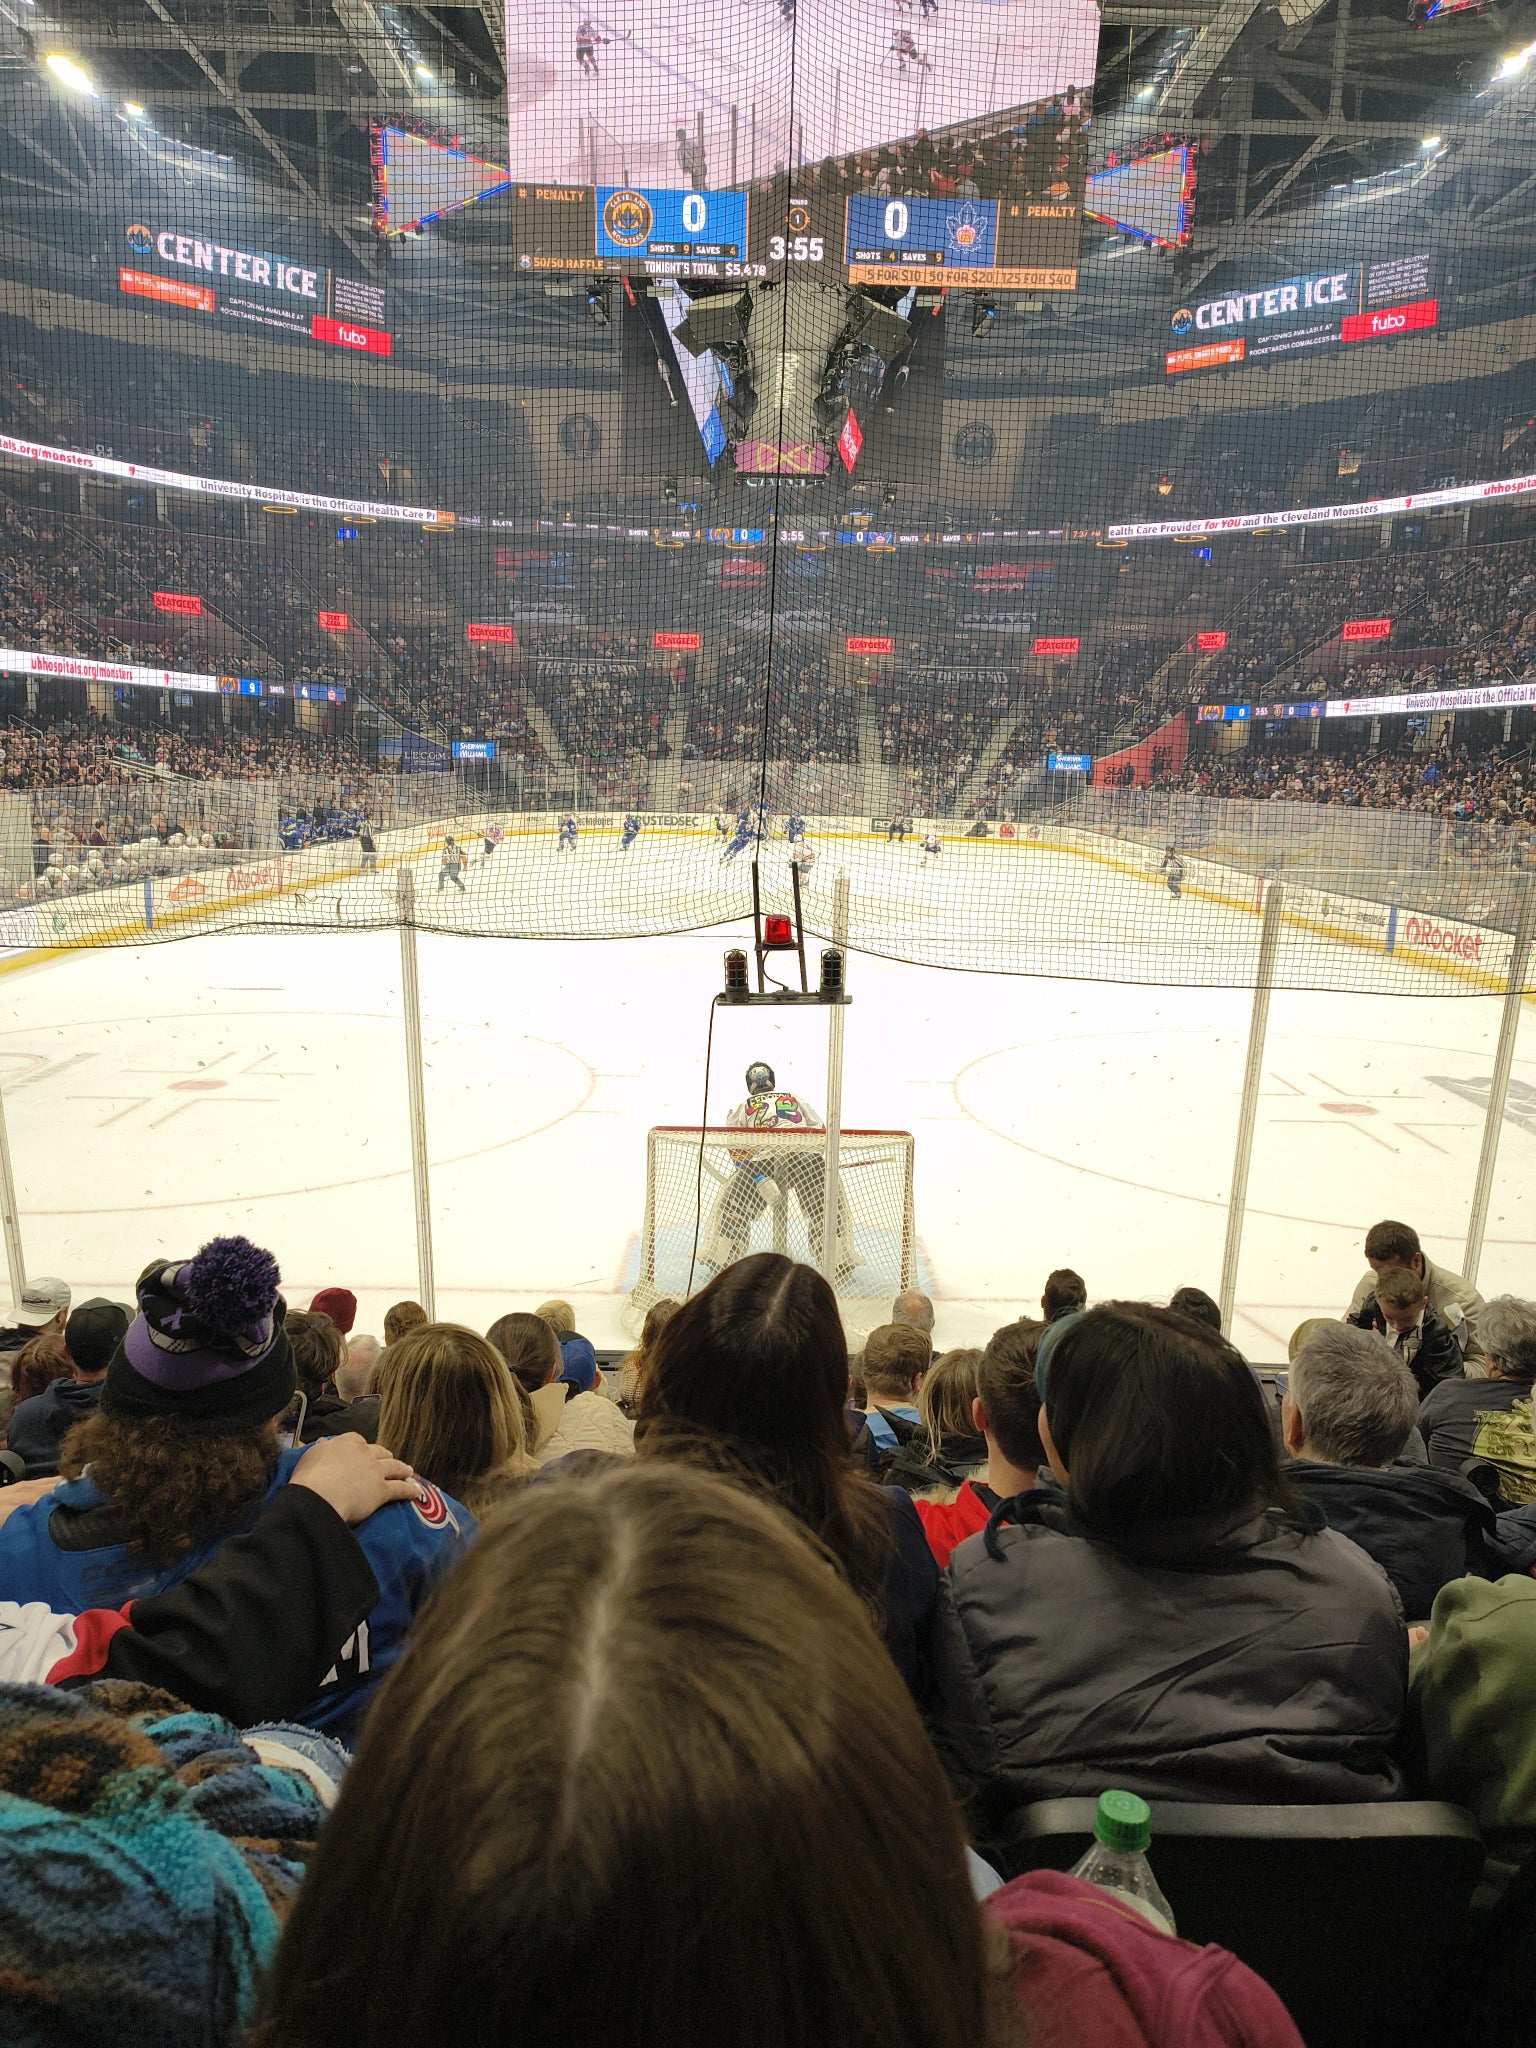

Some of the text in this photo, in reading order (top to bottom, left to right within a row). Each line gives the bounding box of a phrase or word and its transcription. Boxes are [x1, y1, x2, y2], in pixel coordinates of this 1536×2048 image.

[536, 188, 584, 202] PENALTY
[610, 193, 646, 209] CLEVELAND
[683, 194, 706, 232] 0
[794, 214, 800, 224] 1
[884, 201, 908, 239] 0
[1027, 206, 1076, 218] PENALTY
[612, 231, 644, 244] MONSTERS
[650, 244, 676, 252] SHOTS
[683, 244, 690, 254] 9
[696, 246, 720, 255] SAVES
[770, 236, 824, 262] 3:55
[856, 252, 942, 262] SHOTS 4 SAVES 9
[157, 232, 318, 298] CENTER ICE
[534, 258, 564, 268] 50/50
[566, 259, 604, 270] RAFFLE
[644, 260, 766, 276] TONIGHT'S TOTAL $5,478
[868, 269, 1072, 285] 5 FOR $10 50 FOR $20 125 FOR $40
[230, 298, 264, 312] CAPTIONING
[266, 306, 295, 320] AVAILABLE
[1196, 273, 1348, 330] CENTER ICE
[1372, 314, 1406, 331] fubo
[338, 326, 366, 346] fubo
[1258, 332, 1292, 344] CAPTIONING
[1293, 325, 1324, 337] AVAILABLE
[200, 480, 251, 498] University
[254, 488, 300, 504] Hospitals
[302, 496, 310, 506] is
[312, 496, 328, 508] the
[330, 499, 366, 513] Official
[369, 504, 400, 517] Health
[402, 508, 424, 518] Care
[426, 510, 436, 520] Pr
[1110, 503, 1378, 536] ealth Care Provider for YOU and the Cleveland Monsters
[654, 530, 659, 538] 9
[672, 530, 690, 538] SAVES
[694, 530, 700, 538] 4
[740, 530, 748, 540] 0
[780, 531, 804, 541] 3:55
[856, 532, 864, 542] 0
[924, 534, 930, 542] 4
[942, 534, 960, 542] SAVES
[966, 534, 972, 542] 9
[156, 594, 199, 611] SEATGEEK
[470, 626, 511, 639] SEATGEEK
[1344, 622, 1388, 636] SEATGEEK
[658, 636, 698, 646] SEATGEEK
[850, 640, 890, 651] SEATGEEK
[1036, 640, 1077, 652] SEATGEEK
[31, 656, 133, 682] uhhospitals.org/monsters
[537, 662, 639, 677] THE DEEP END
[249, 682, 256, 692] 9
[302, 686, 308, 698] 4
[1406, 687, 1536, 710] University Hospitals is the Official H
[1238, 708, 1245, 717] 0
[1288, 706, 1294, 715] 0
[404, 750, 446, 760] LECOM
[1152, 746, 1172, 758] SEAT
[630, 815, 699, 827] RUSTEDSEC
[236, 864, 273, 890] Rocket
[1422, 917, 1482, 962] Rocket
